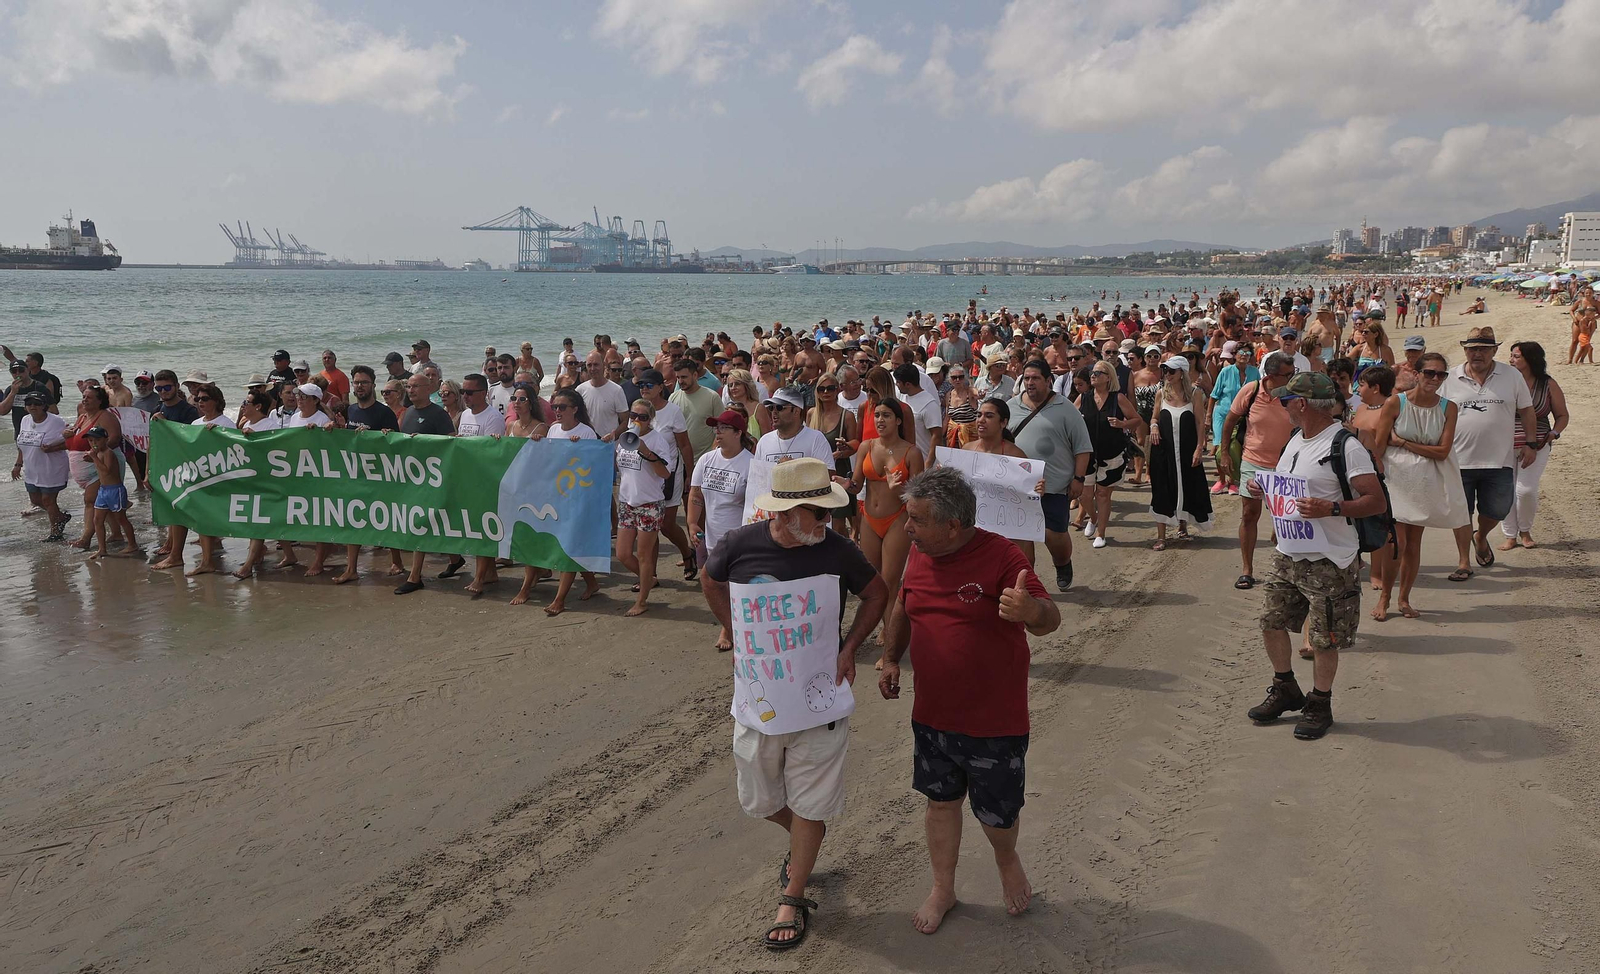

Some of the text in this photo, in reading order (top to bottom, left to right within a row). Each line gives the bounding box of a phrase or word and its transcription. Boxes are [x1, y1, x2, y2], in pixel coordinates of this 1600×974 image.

[160, 443, 250, 493] VERDEMAR
[267, 449, 443, 488] SALVEMOS
[707, 483, 726, 491] MUNDO
[1273, 474, 1307, 498] PRESENTE
[1265, 494, 1285, 517] NO
[228, 494, 504, 542] EL RINCONCILLO
[1275, 518, 1314, 540] FUTURO
[743, 630, 765, 655] EL
